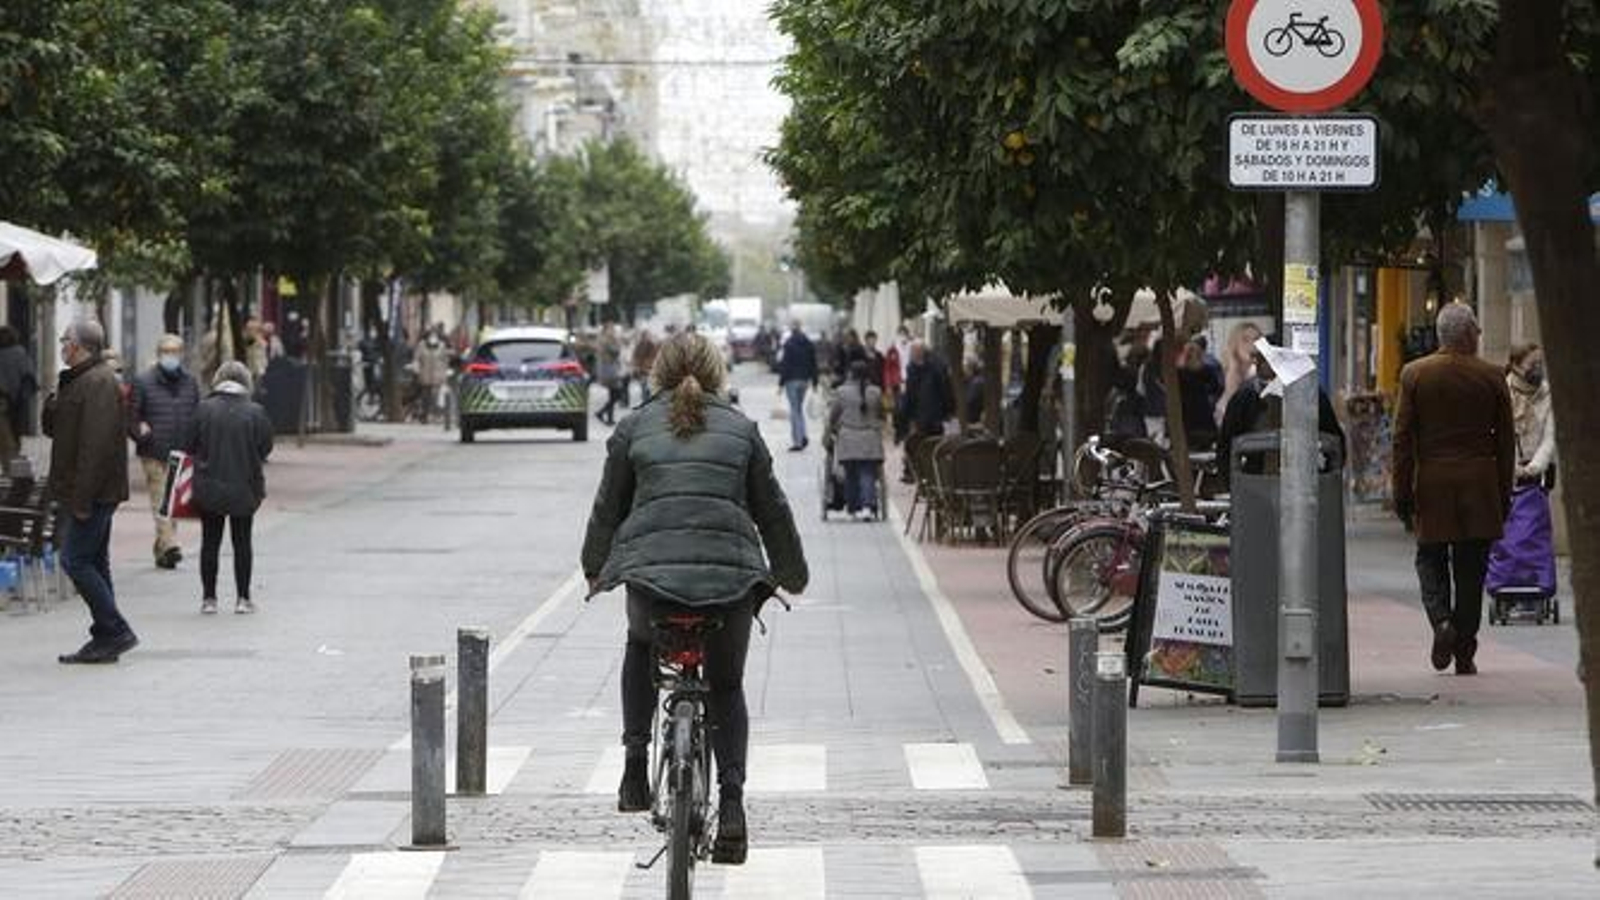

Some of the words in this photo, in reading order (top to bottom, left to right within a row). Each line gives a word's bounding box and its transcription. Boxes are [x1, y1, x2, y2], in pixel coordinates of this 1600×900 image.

[1241, 124, 1257, 136] DE
[1260, 124, 1299, 136] LUNES
[1302, 124, 1310, 136] A
[1314, 124, 1365, 136] VIERNES
[1256, 139, 1271, 151] DE
[1290, 140, 1300, 151] H
[1302, 140, 1311, 151] A
[1313, 140, 1326, 151] 21
[1330, 139, 1339, 151] H
[1341, 140, 1349, 151] Y
[1294, 155, 1302, 166] Y
[1306, 154, 1370, 167] DOMINGOS
[1263, 170, 1279, 182] DE
[1282, 171, 1294, 182] 10
[1297, 171, 1306, 182] H
[1308, 171, 1317, 182] A
[1320, 171, 1332, 182] 21
[1335, 171, 1345, 182] H
